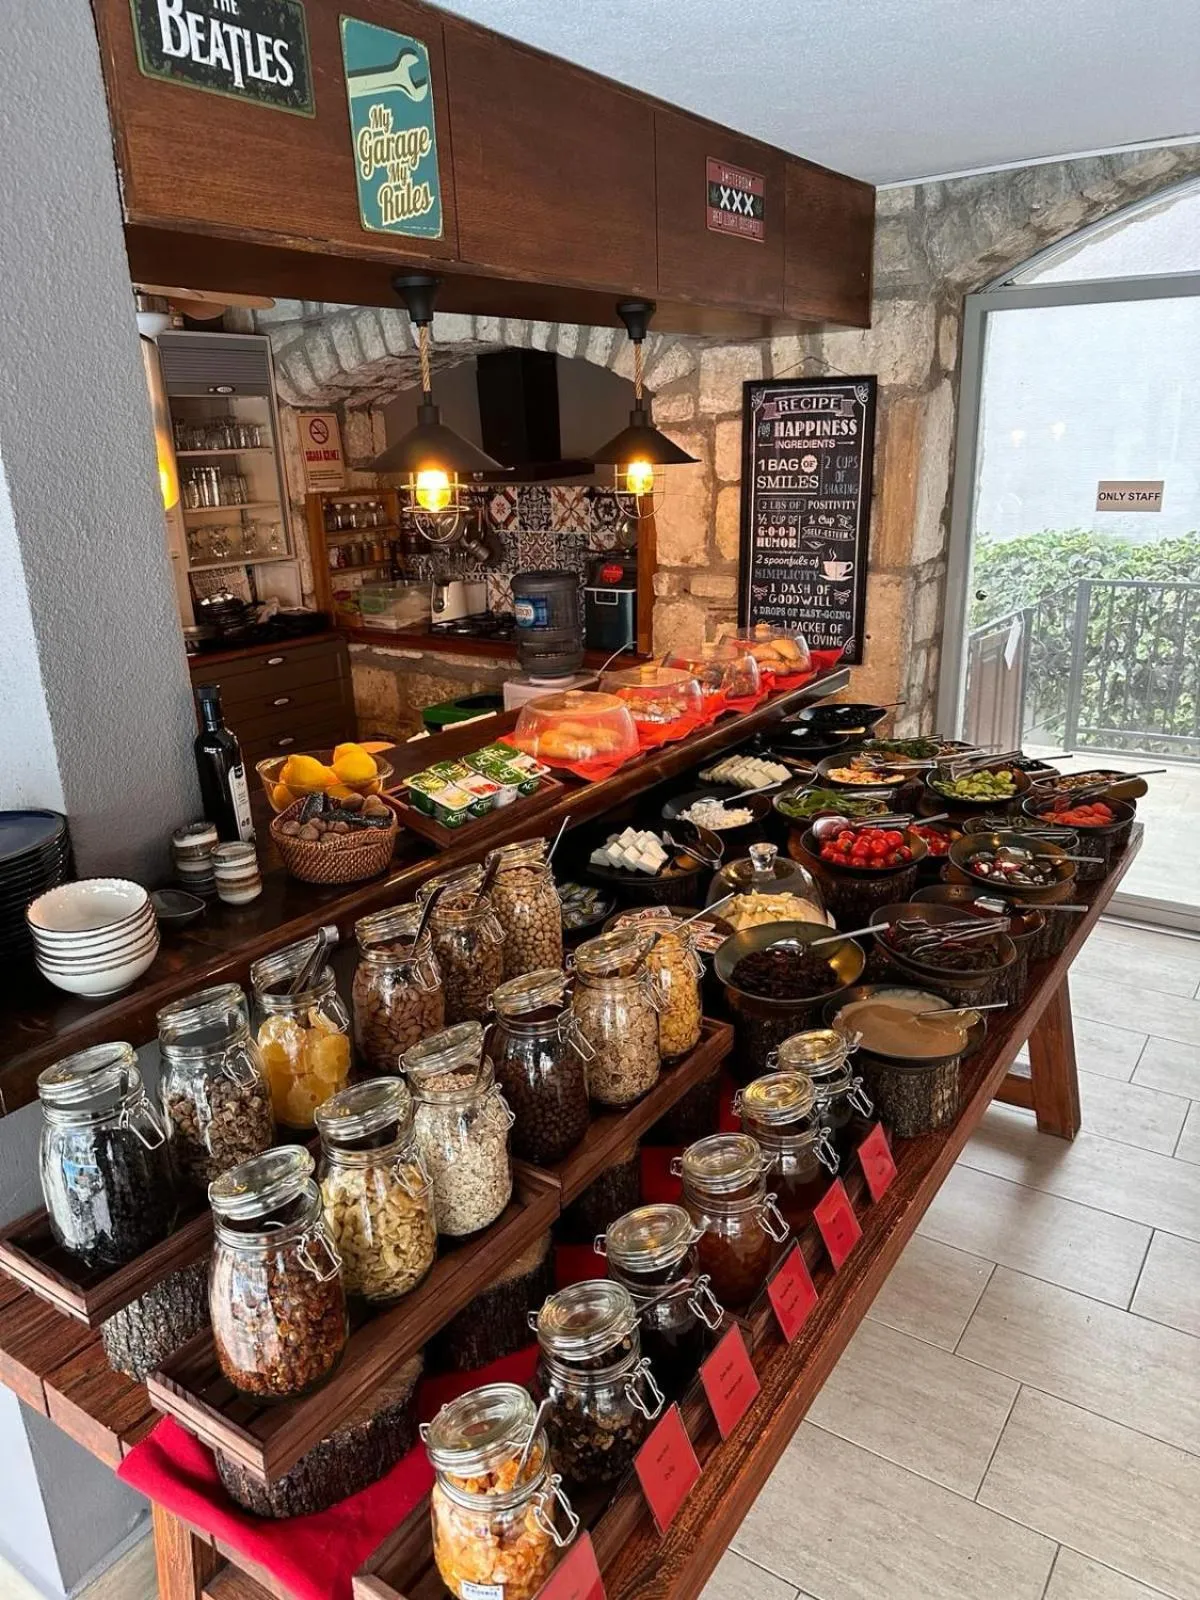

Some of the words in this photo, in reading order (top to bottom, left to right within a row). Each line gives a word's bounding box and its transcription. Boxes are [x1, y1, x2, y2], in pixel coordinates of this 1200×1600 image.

[157, 0, 294, 89] BEATLES
[369, 104, 393, 133] My
[358, 126, 432, 180] Garage
[387, 161, 411, 188] My
[378, 178, 435, 226] Rules
[720, 185, 754, 217] XXX
[778, 397, 838, 411] RECIPE
[774, 419, 858, 437] HAPPINESS
[775, 439, 836, 449] INGREDIENTS
[757, 475, 819, 489] SMILES
[1098, 492, 1126, 501] ONLY
[1128, 492, 1161, 501] STAFF
[808, 500, 857, 510] POSITIVITY
[757, 537, 796, 548] HUMOR
[781, 583, 811, 594] DASH
[817, 585, 831, 595] OF
[769, 594, 832, 607] GOODWILL
[760, 606, 785, 615] DROPS
[787, 608, 798, 616] OF
[791, 621, 825, 633] PACKET
[830, 623, 842, 634] OF
[807, 636, 843, 647] LOVING
